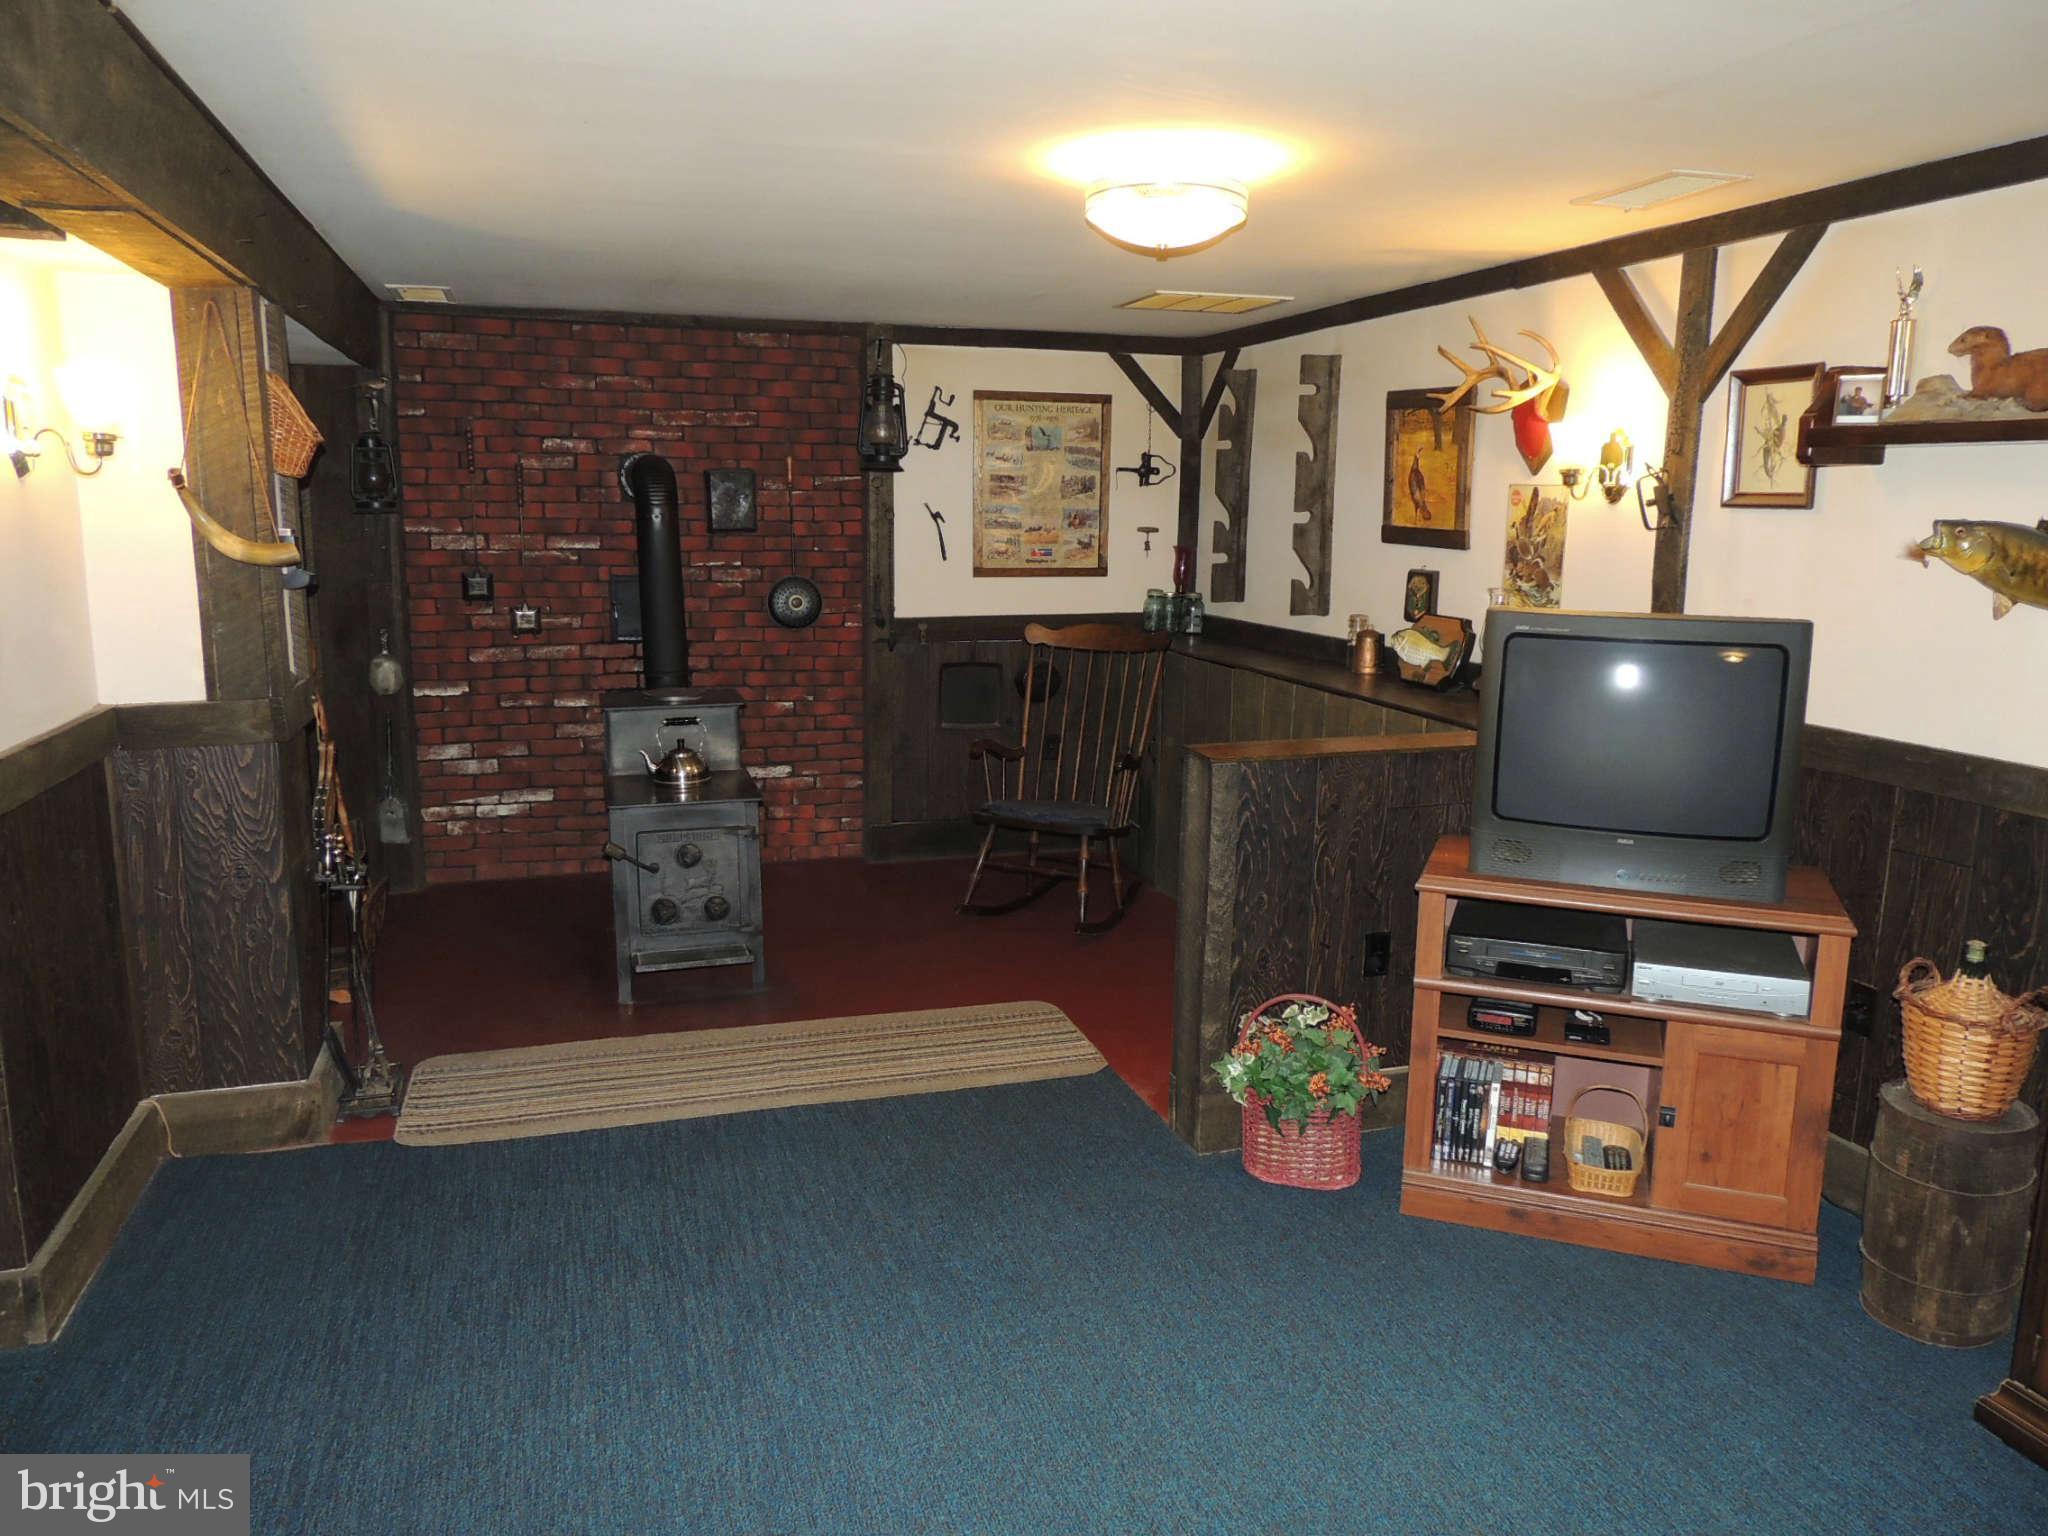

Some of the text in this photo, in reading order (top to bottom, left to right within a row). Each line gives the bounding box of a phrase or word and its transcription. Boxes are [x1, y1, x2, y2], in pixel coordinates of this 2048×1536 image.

[994, 403, 1093, 415] OUR HUNTING HERITAGE
